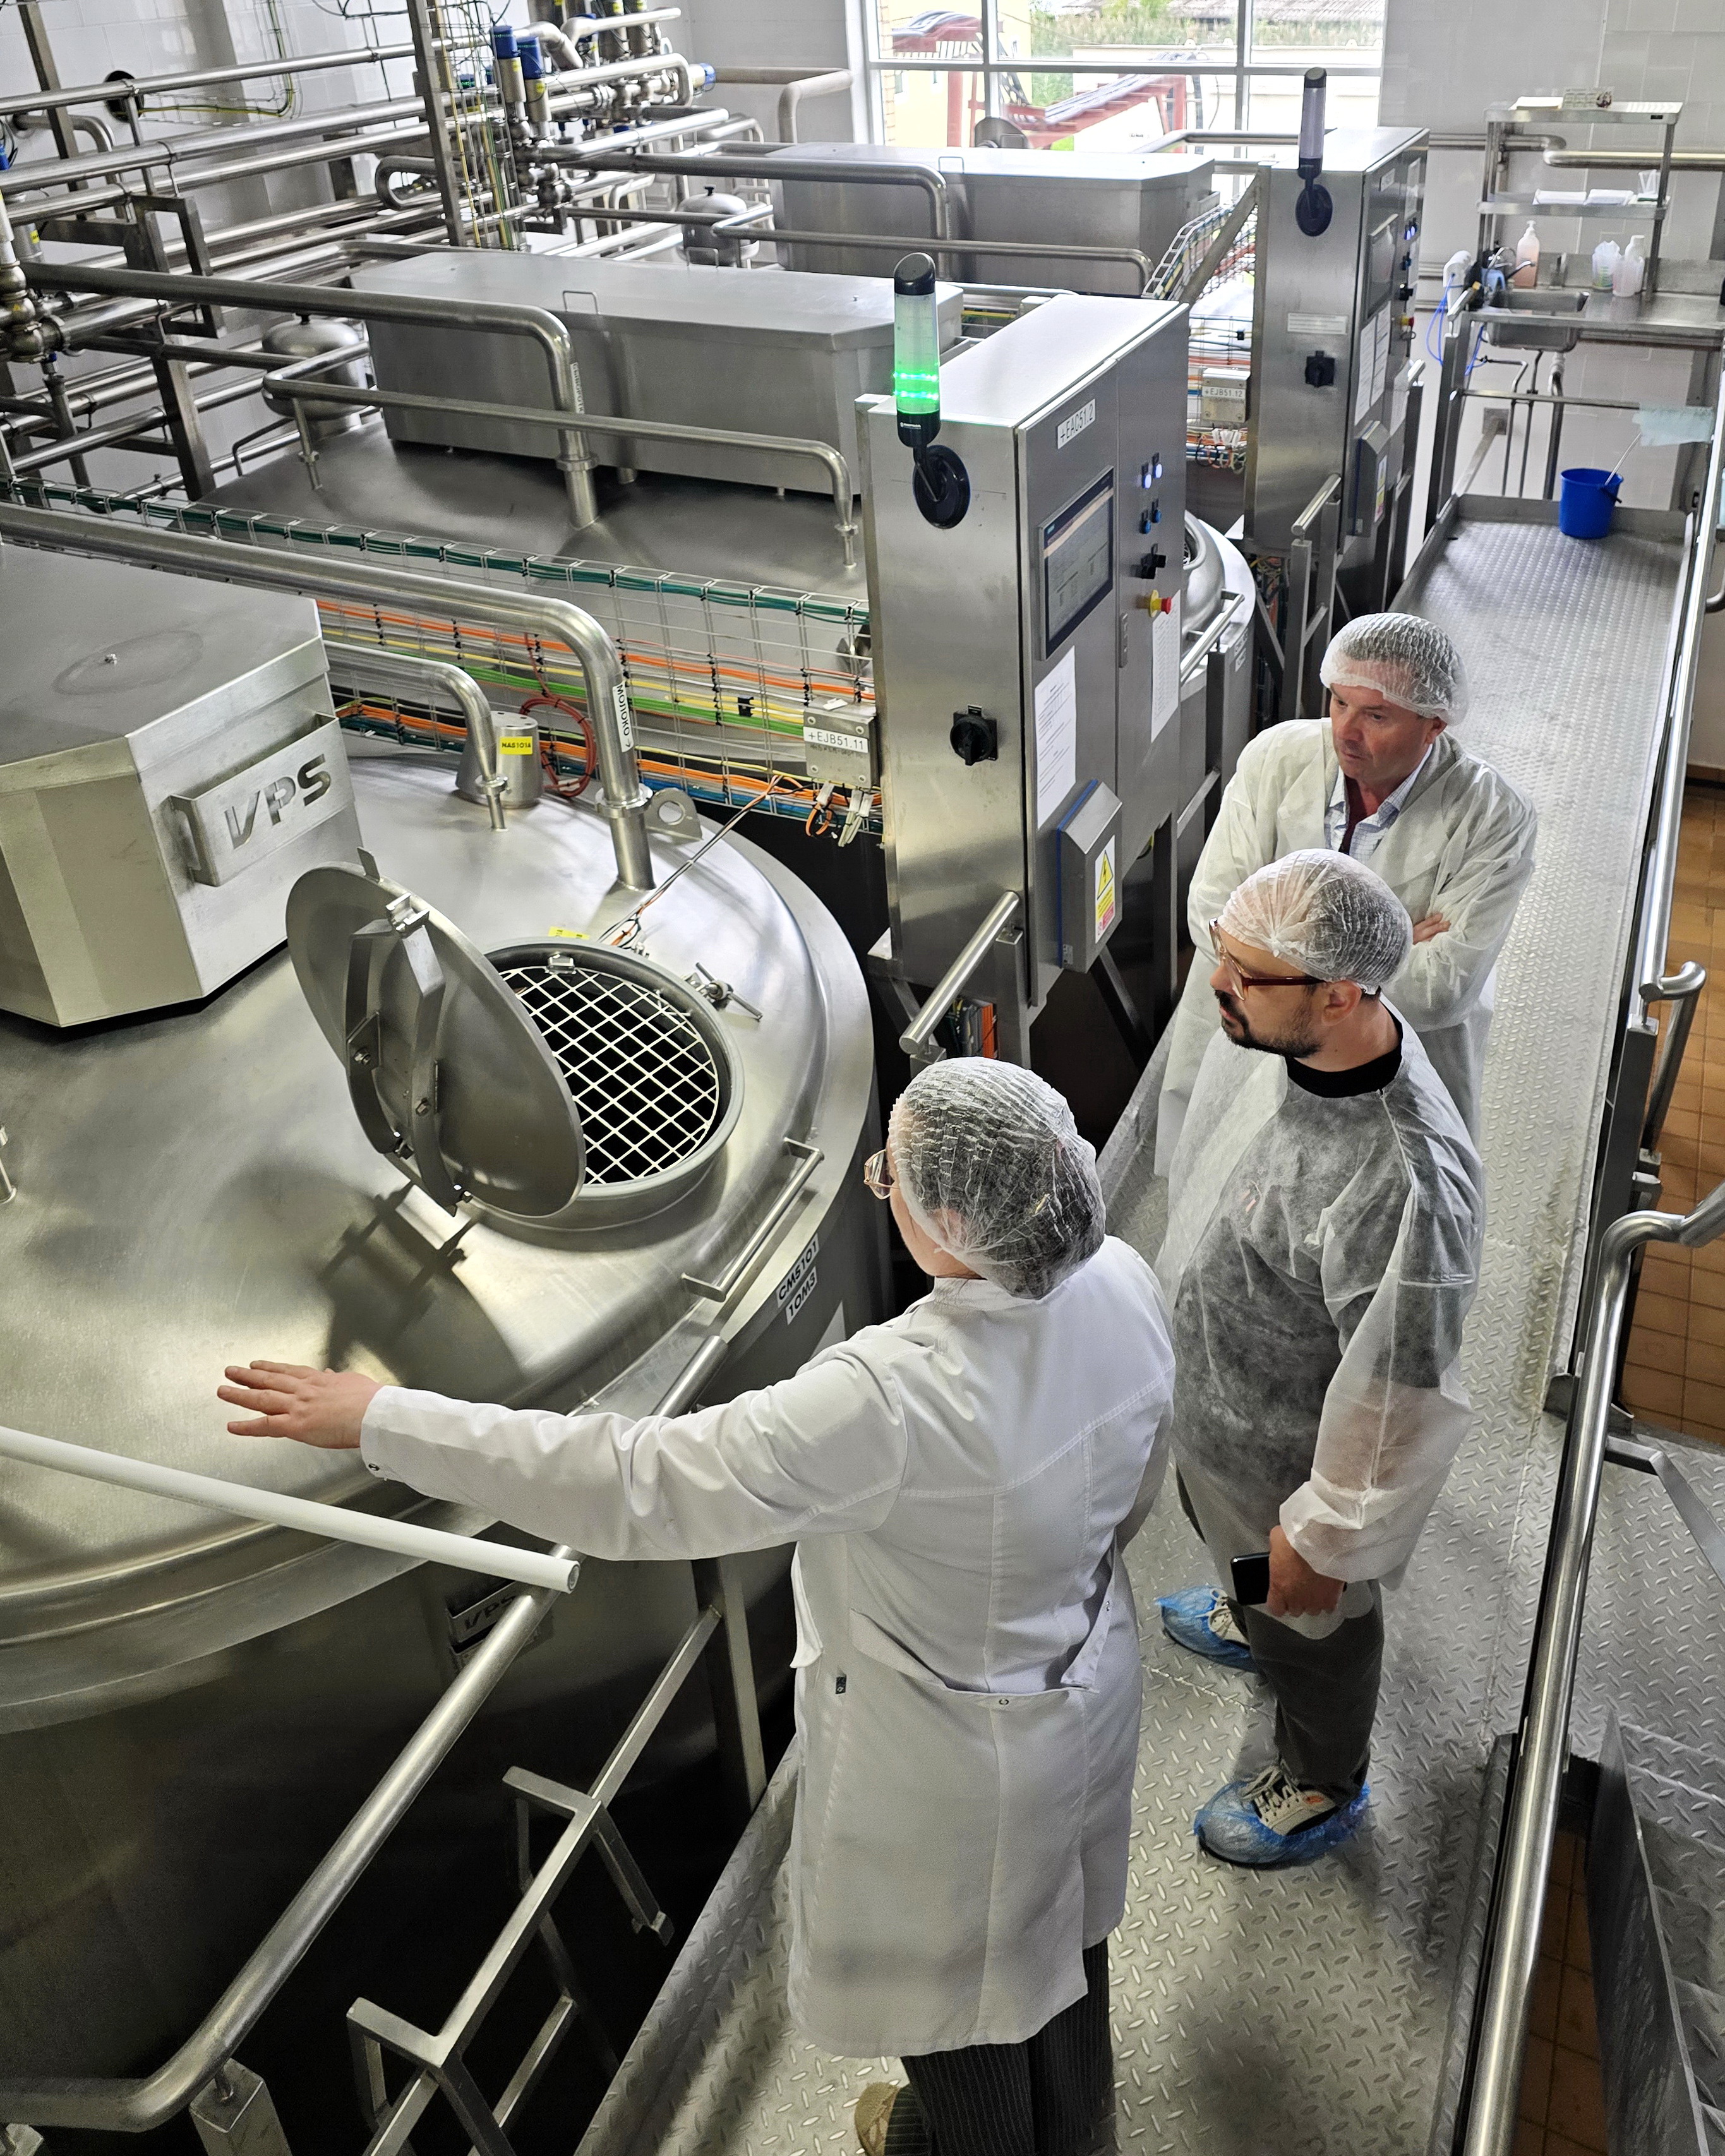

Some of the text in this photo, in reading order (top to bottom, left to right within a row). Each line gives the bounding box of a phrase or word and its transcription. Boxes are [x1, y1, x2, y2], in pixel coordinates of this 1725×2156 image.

[573, 363, 584, 412] СЫВОРОТК
[616, 684, 630, 736] МОЛОКО
[808, 731, 863, 750] +EJB51.11
[224, 753, 331, 850] VPS
